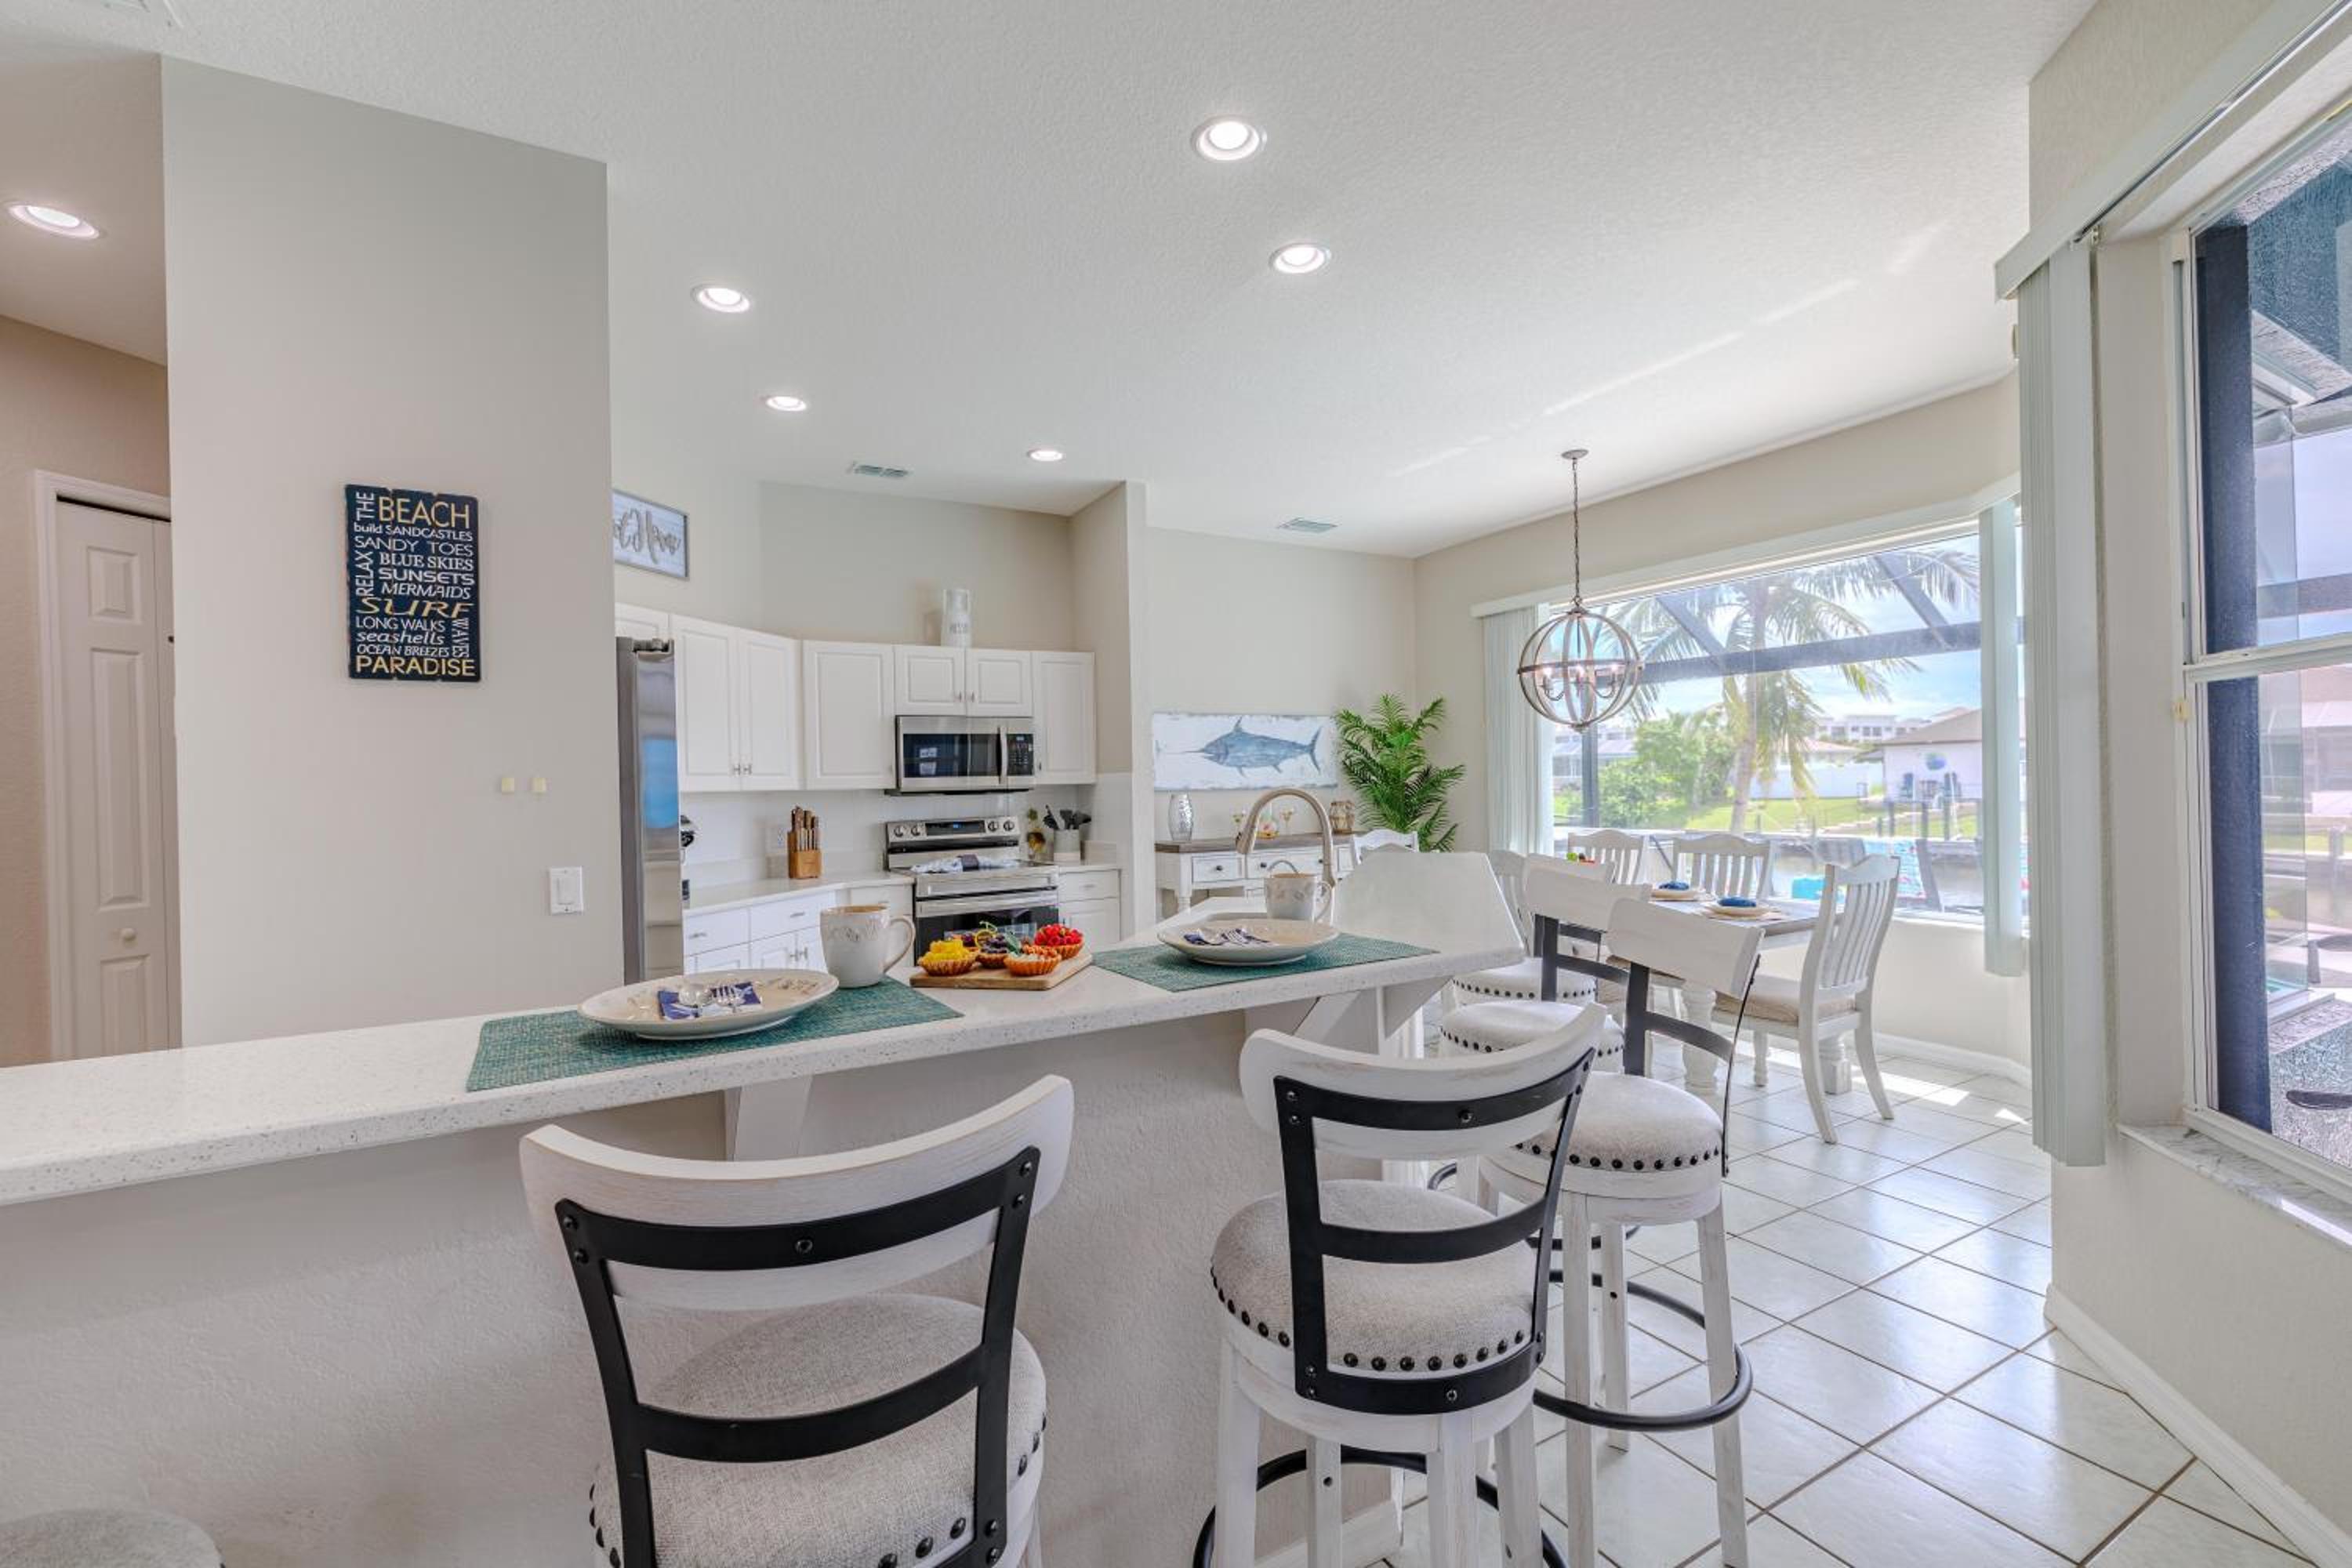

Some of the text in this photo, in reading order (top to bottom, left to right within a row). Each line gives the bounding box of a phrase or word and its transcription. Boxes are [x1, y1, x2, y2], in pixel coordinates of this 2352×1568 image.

[356, 492, 373, 521] THE
[378, 496, 470, 528] BEACH
[354, 523, 473, 541] build SANDCASTLES
[354, 536, 473, 557] SANDY TOES
[379, 554, 474, 571] BLUE SKIES
[356, 550, 373, 597] RELAX
[379, 568, 474, 586] SUNSETS
[381, 583, 471, 599] MERMAIDS
[356, 597, 474, 618] SURF
[356, 615, 445, 631] LONG WALKS
[356, 630, 445, 645] seashells
[452, 618, 469, 657] WAVES
[358, 644, 449, 657] OCEAN BREEZES
[356, 655, 476, 676] PARADISE
